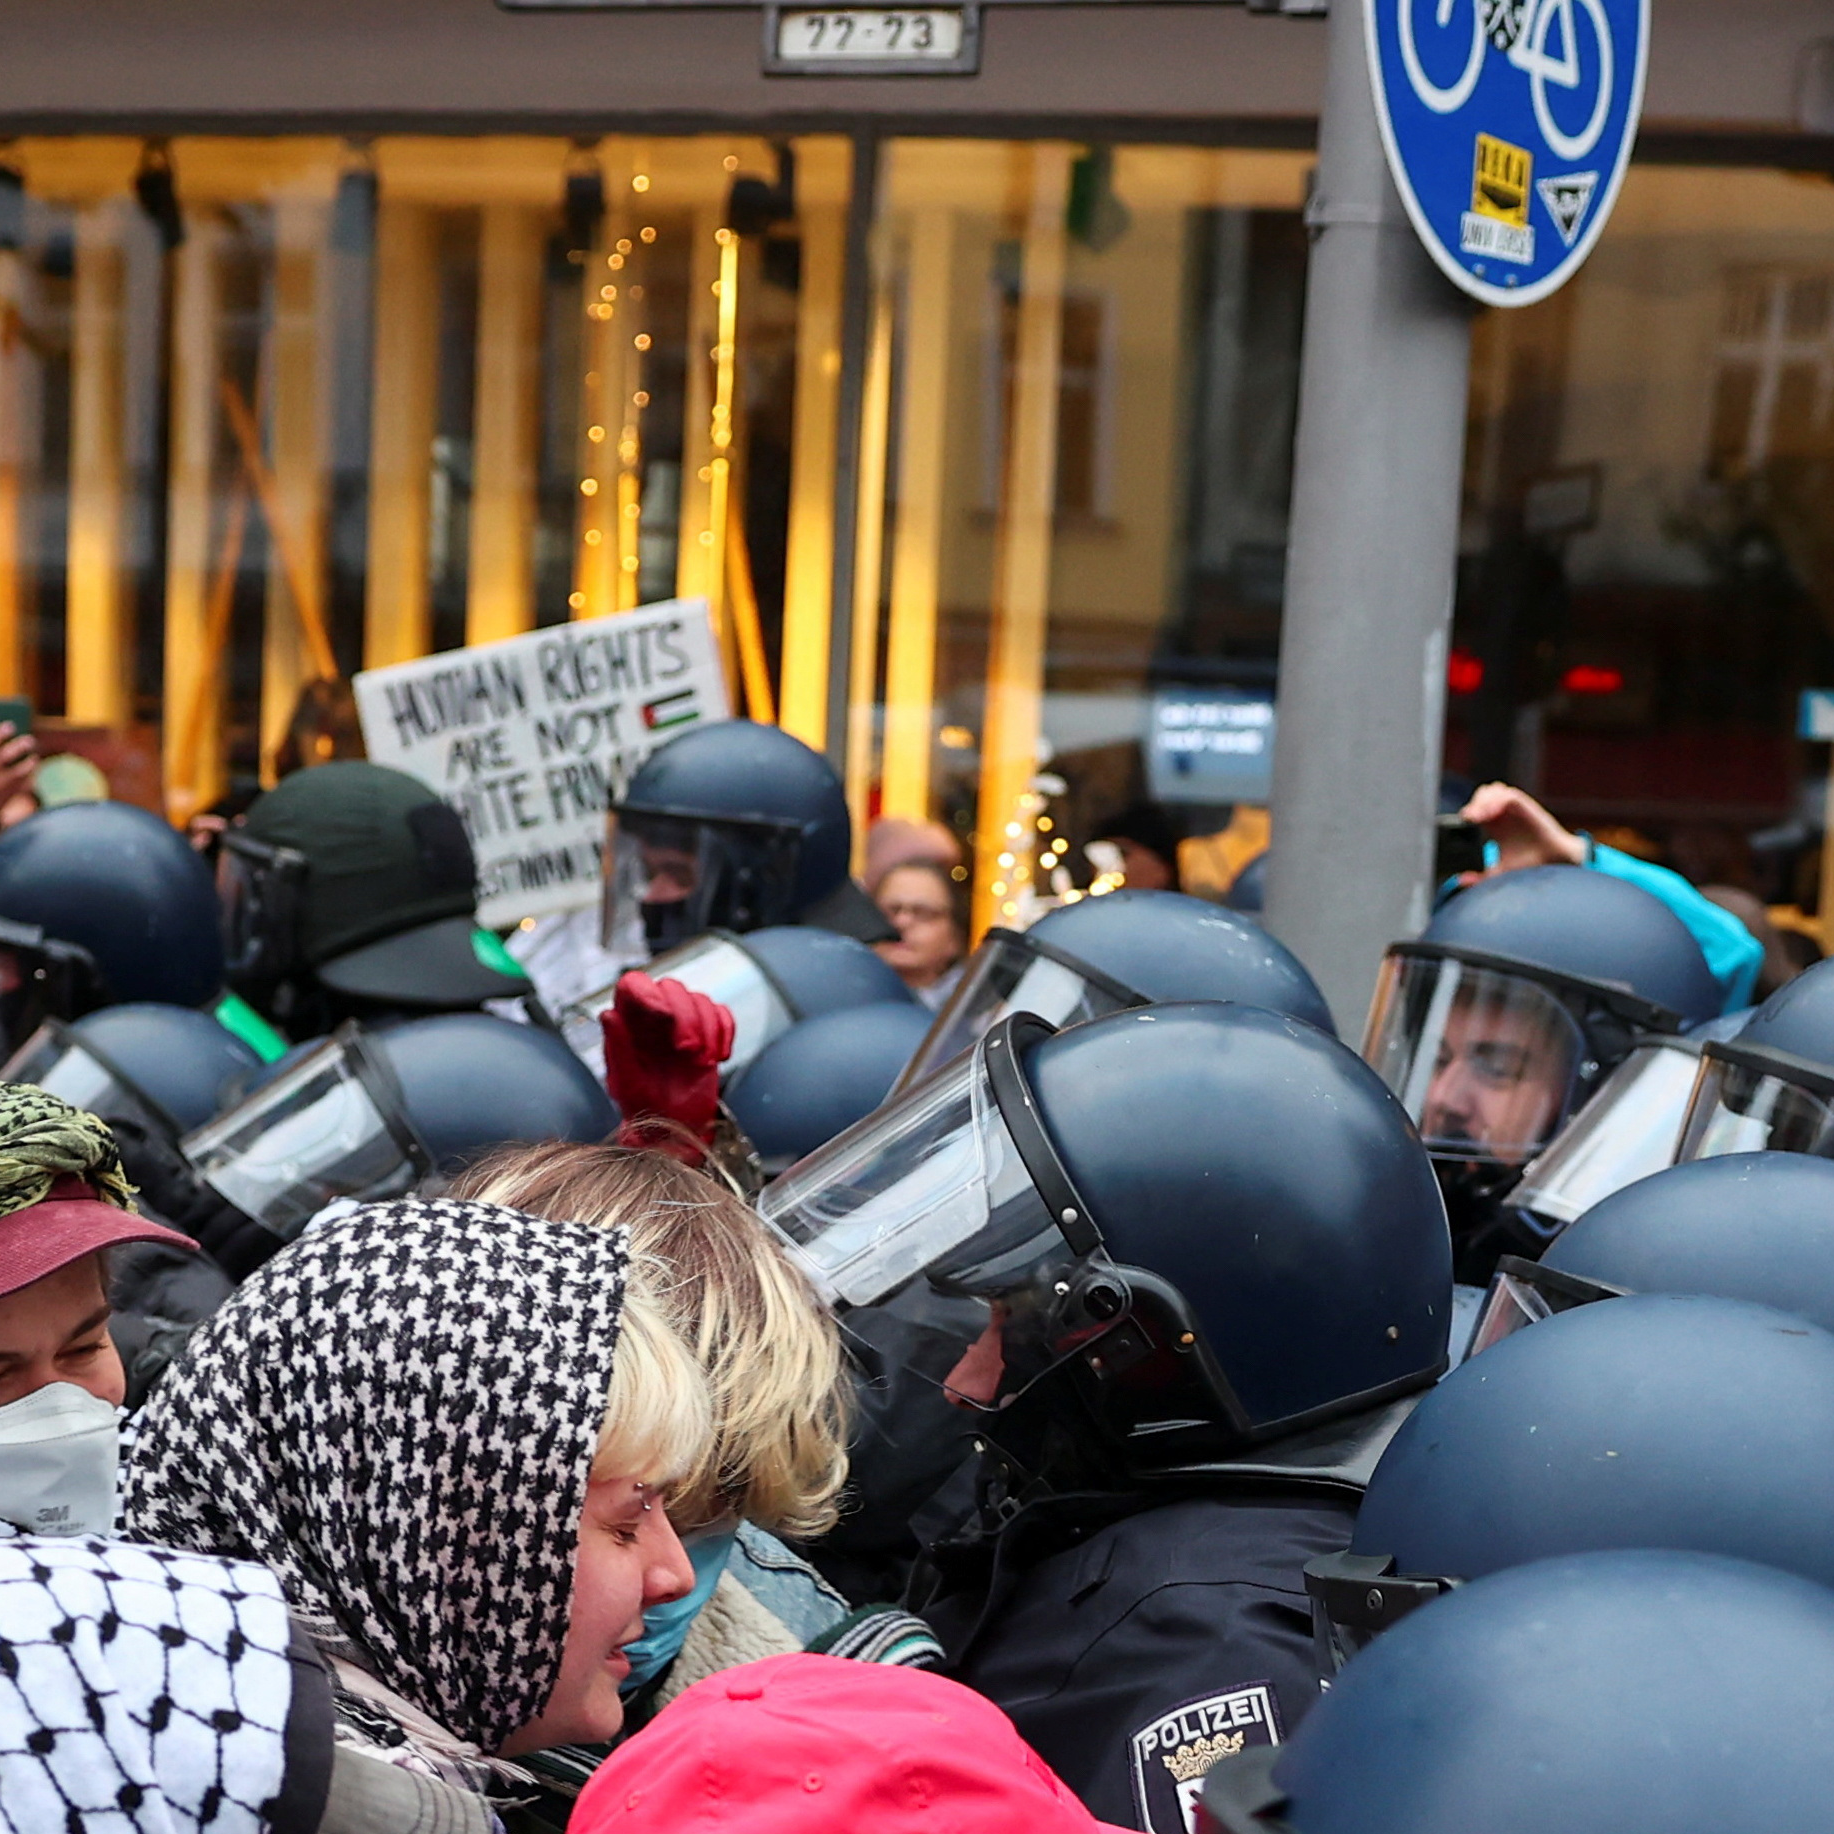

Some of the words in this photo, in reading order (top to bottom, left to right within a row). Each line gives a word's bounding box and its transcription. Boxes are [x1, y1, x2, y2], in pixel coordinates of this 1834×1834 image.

[385, 655, 527, 748] HUMAN
[535, 619, 692, 703] RIGHTS
[445, 724, 514, 783] ARE
[535, 702, 622, 757] NOT
[34, 1505, 70, 1523] 3M
[1140, 1696, 1264, 1762] POLIZEI
